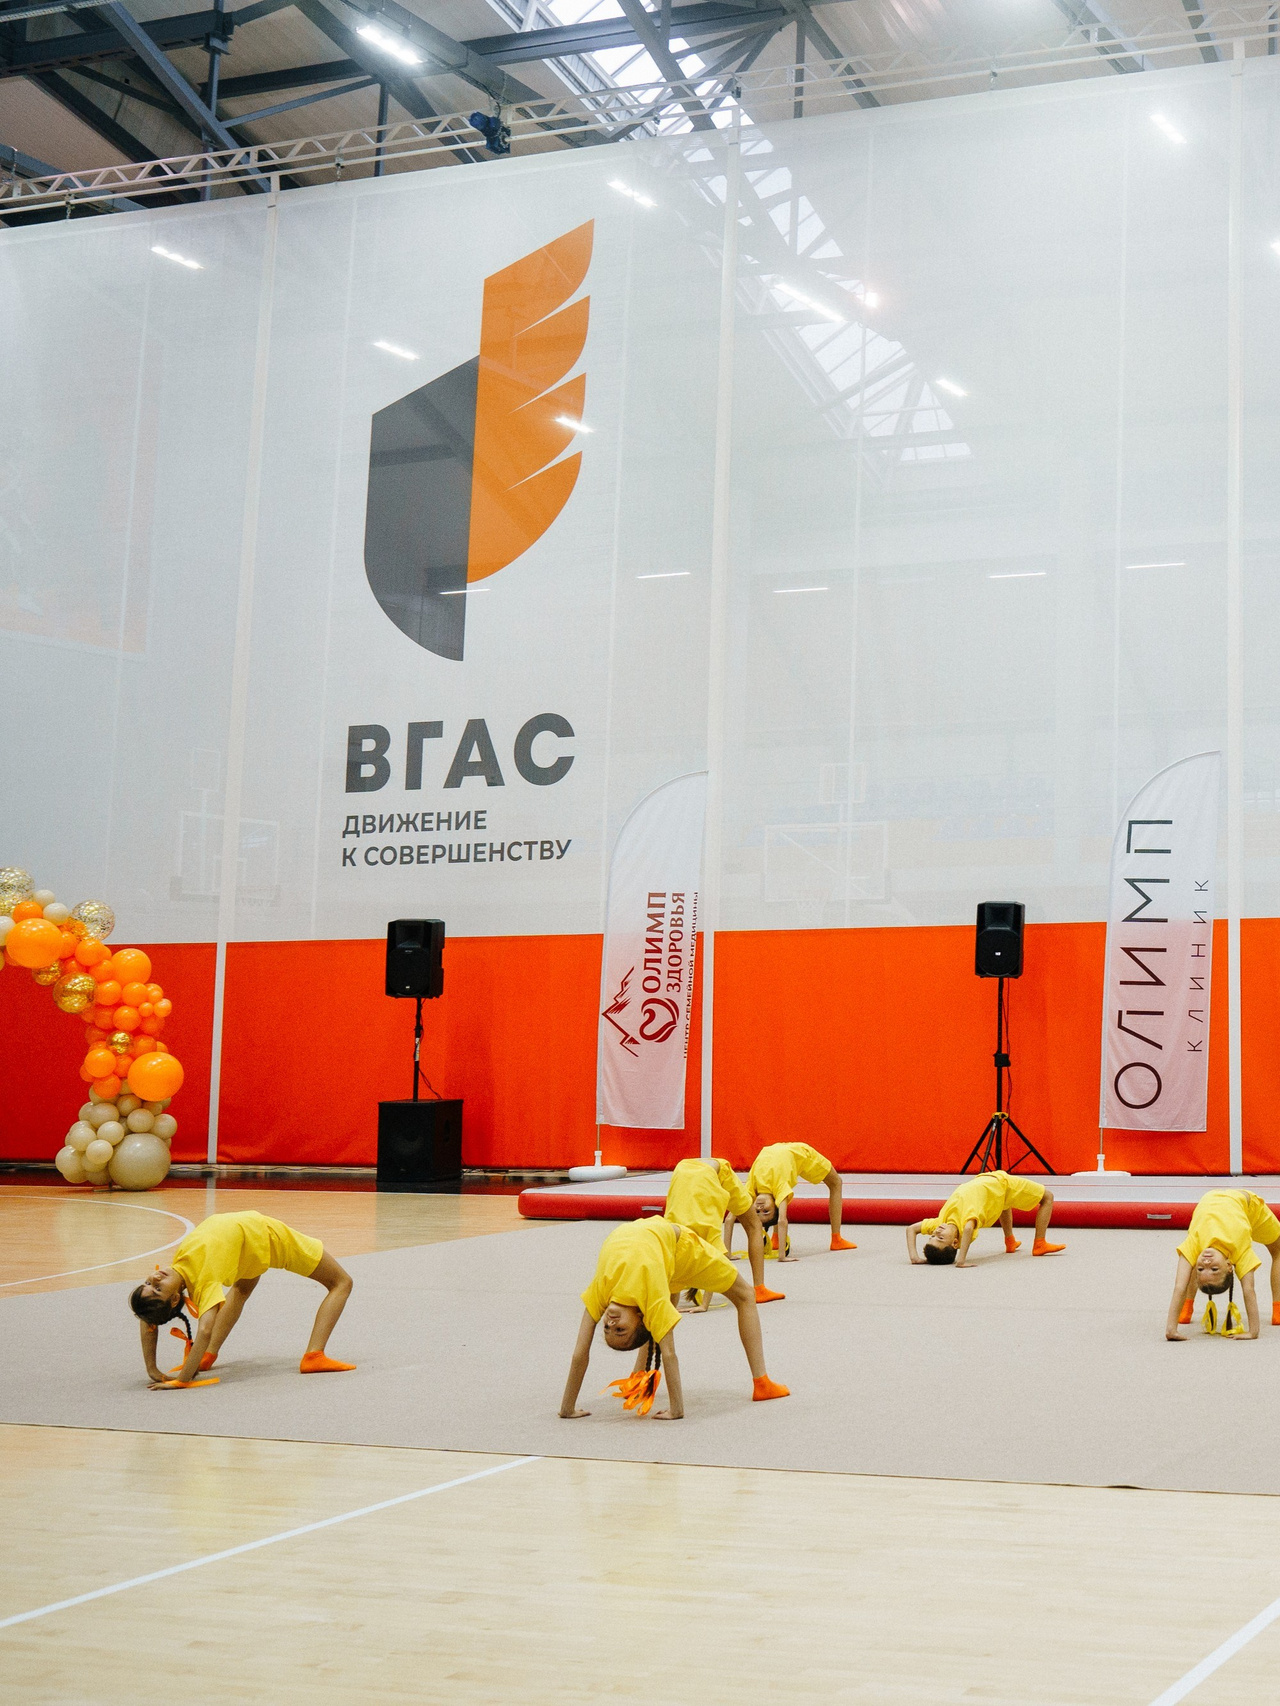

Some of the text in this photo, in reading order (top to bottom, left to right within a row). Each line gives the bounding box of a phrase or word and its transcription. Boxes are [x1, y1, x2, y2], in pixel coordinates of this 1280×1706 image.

[345, 712, 575, 793] ВГАС
[342, 810, 487, 838] ДВИЖЕНИЕ
[342, 839, 572, 867] К СОВЕРШЕНСТВУ
[642, 892, 667, 994] ОЛИМП
[666, 892, 686, 993] ЗДОРОВЬЯ
[689, 891, 699, 957] МЕДИЦИНЫ
[1114, 819, 1173, 1110] ОЛИМП
[685, 960, 694, 1021] СЕМЕЙНОЙ
[1187, 879, 1209, 1052] КЛИНИК
